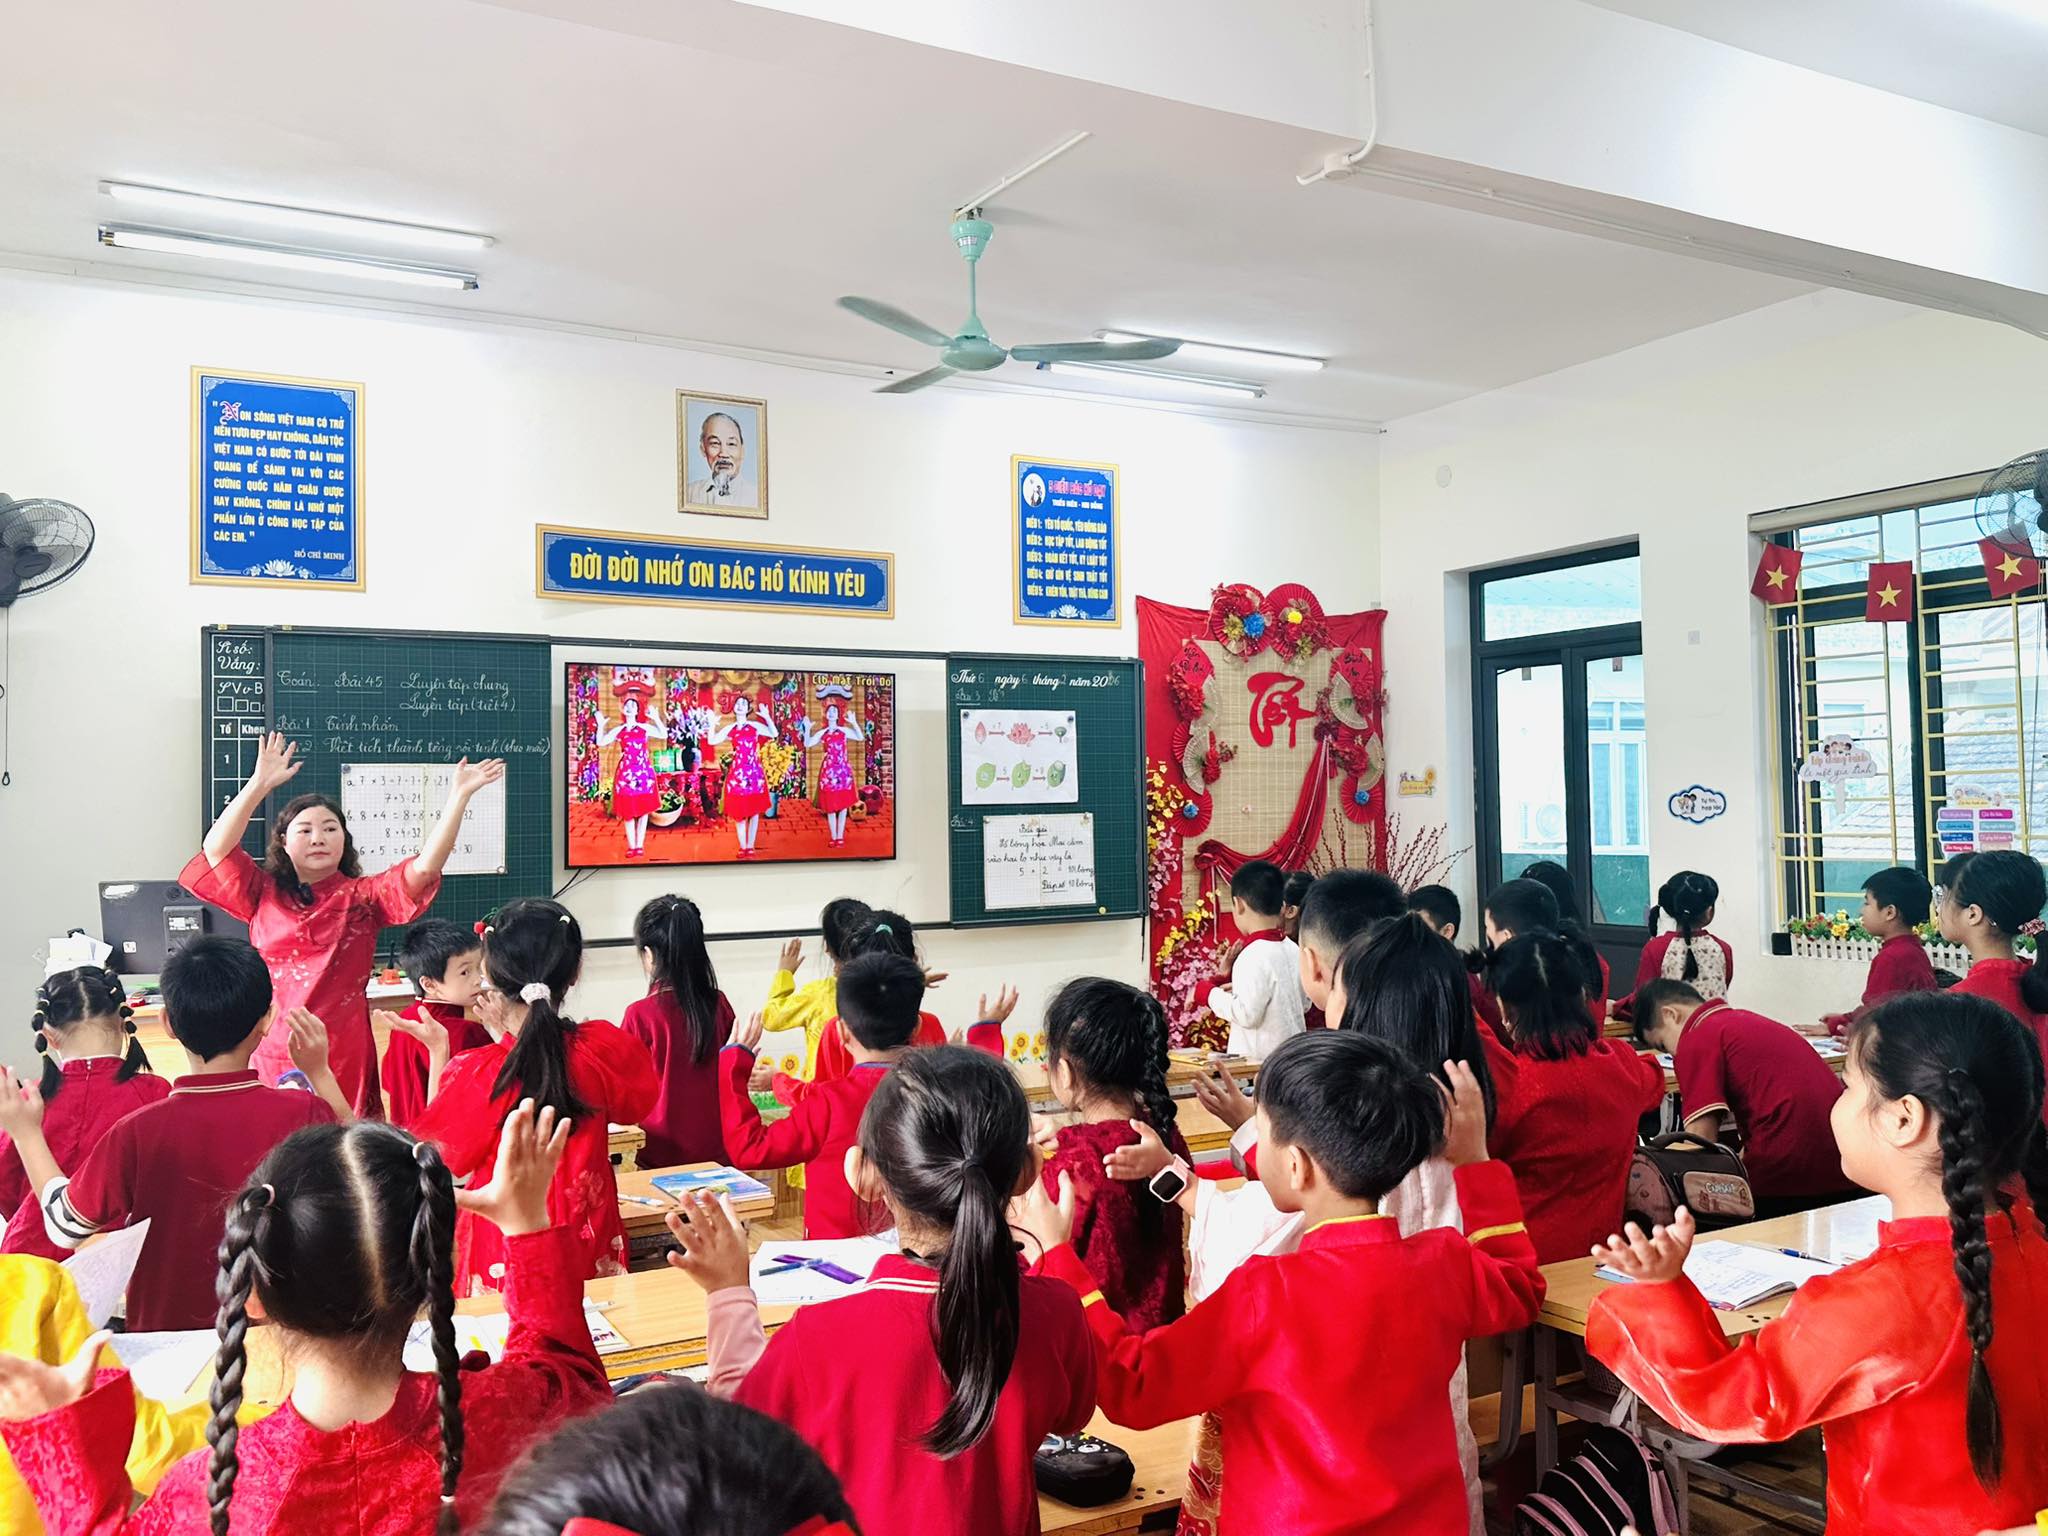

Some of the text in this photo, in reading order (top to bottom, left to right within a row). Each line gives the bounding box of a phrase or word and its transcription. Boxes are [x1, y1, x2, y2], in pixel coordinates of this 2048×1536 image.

[253, 411, 275, 423] SÔNG
[278, 414, 293, 426] VIỆT
[296, 416, 314, 427] NAM
[316, 416, 327, 428] CÓ
[329, 416, 344, 430] TRỞ
[214, 424, 344, 448] NÊN TƯƠI ĐẸP HAY KHÔNG, DÂN TỘC
[214, 442, 344, 463] VIỆT NAM CÓ BƯỚC TỚI ĐÀI VINH
[214, 461, 241, 472] QUANG
[264, 463, 285, 475] SÁNH
[291, 467, 304, 477] VAI
[310, 466, 322, 478] VỚI
[329, 469, 344, 479] CÁC
[214, 477, 241, 490] CƯỜNG
[247, 478, 268, 492] QUỐC
[298, 483, 318, 495] CHÂU
[323, 486, 344, 498] ĐƯỢC
[214, 496, 229, 506] HAY
[233, 496, 263, 509] KHÔNG,
[267, 498, 291, 510] CHÍNH
[295, 500, 304, 511] LÀ
[327, 502, 344, 515] MỘT
[240, 513, 255, 525] LỚN
[258, 512, 264, 526] Ở
[267, 515, 289, 527] CÔNG
[292, 518, 308, 530] HỌC
[311, 518, 325, 532] TẬP
[329, 517, 344, 531] CỦA
[214, 529, 230, 542] CÁC
[308, 550, 321, 559] CHÍ
[323, 552, 344, 560] MINH
[570, 548, 866, 597] ĐỜI ĐỜI NHỚ ƠN BÁC HỒ KÍNH YÊU
[233, 640, 252, 655] số:
[217, 656, 260, 674] Vắng:
[365, 676, 383, 687] 45
[951, 669, 976, 684] Thứ
[978, 673, 984, 683] 6
[995, 674, 1020, 689] ngày
[1033, 673, 1059, 691] tháng
[1070, 677, 1091, 687] năm
[220, 723, 265, 733] Tổ Khen
[225, 755, 229, 764] 1
[224, 796, 231, 805] 2
[1020, 868, 1024, 876] 5
